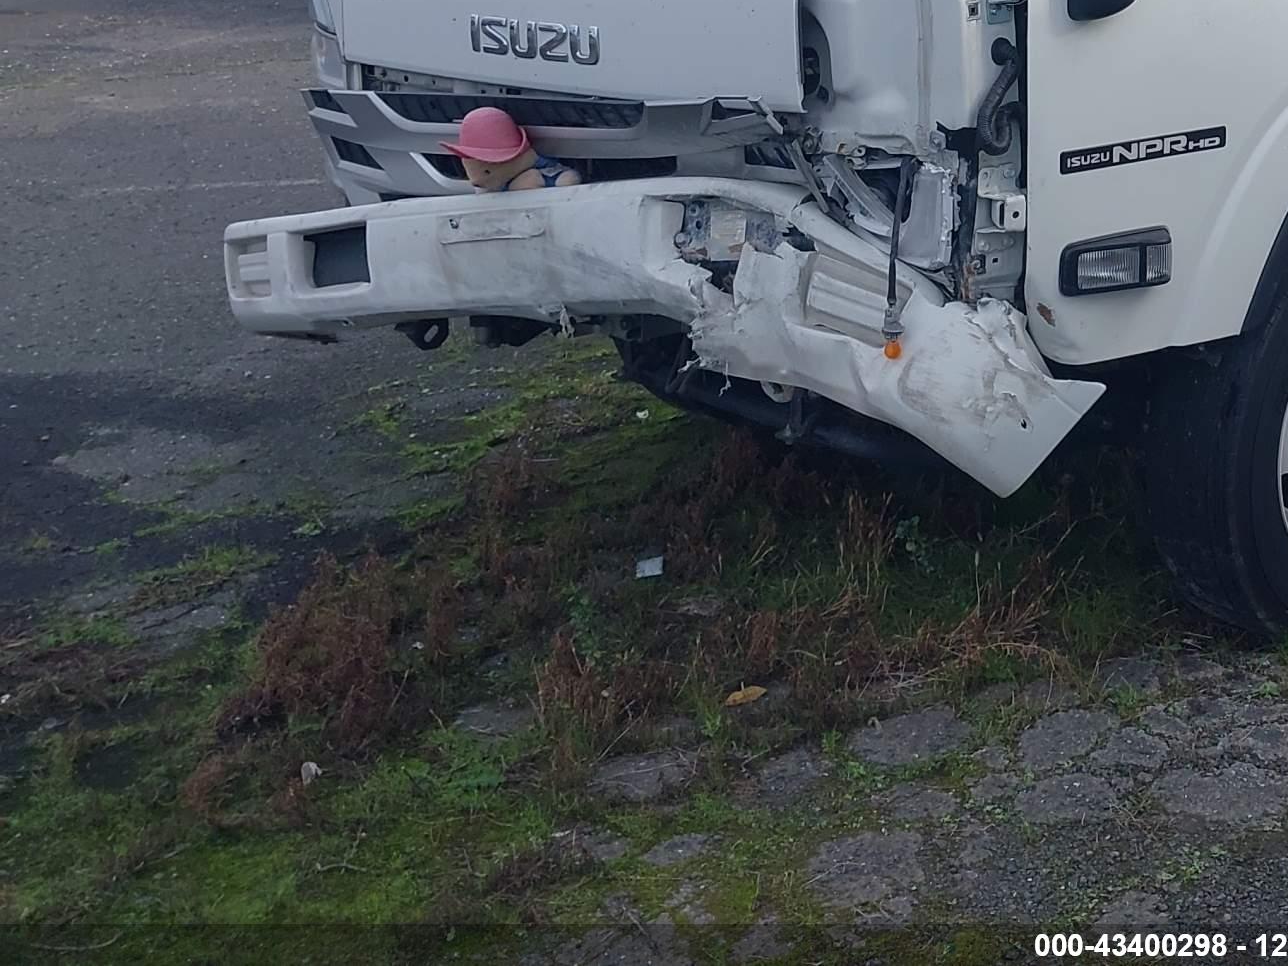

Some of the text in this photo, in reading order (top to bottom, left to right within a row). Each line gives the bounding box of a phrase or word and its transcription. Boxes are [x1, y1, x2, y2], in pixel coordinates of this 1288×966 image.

[470, 13, 600, 65] ISUZU
[1066, 135, 1221, 168] ISUZU NPR HD
